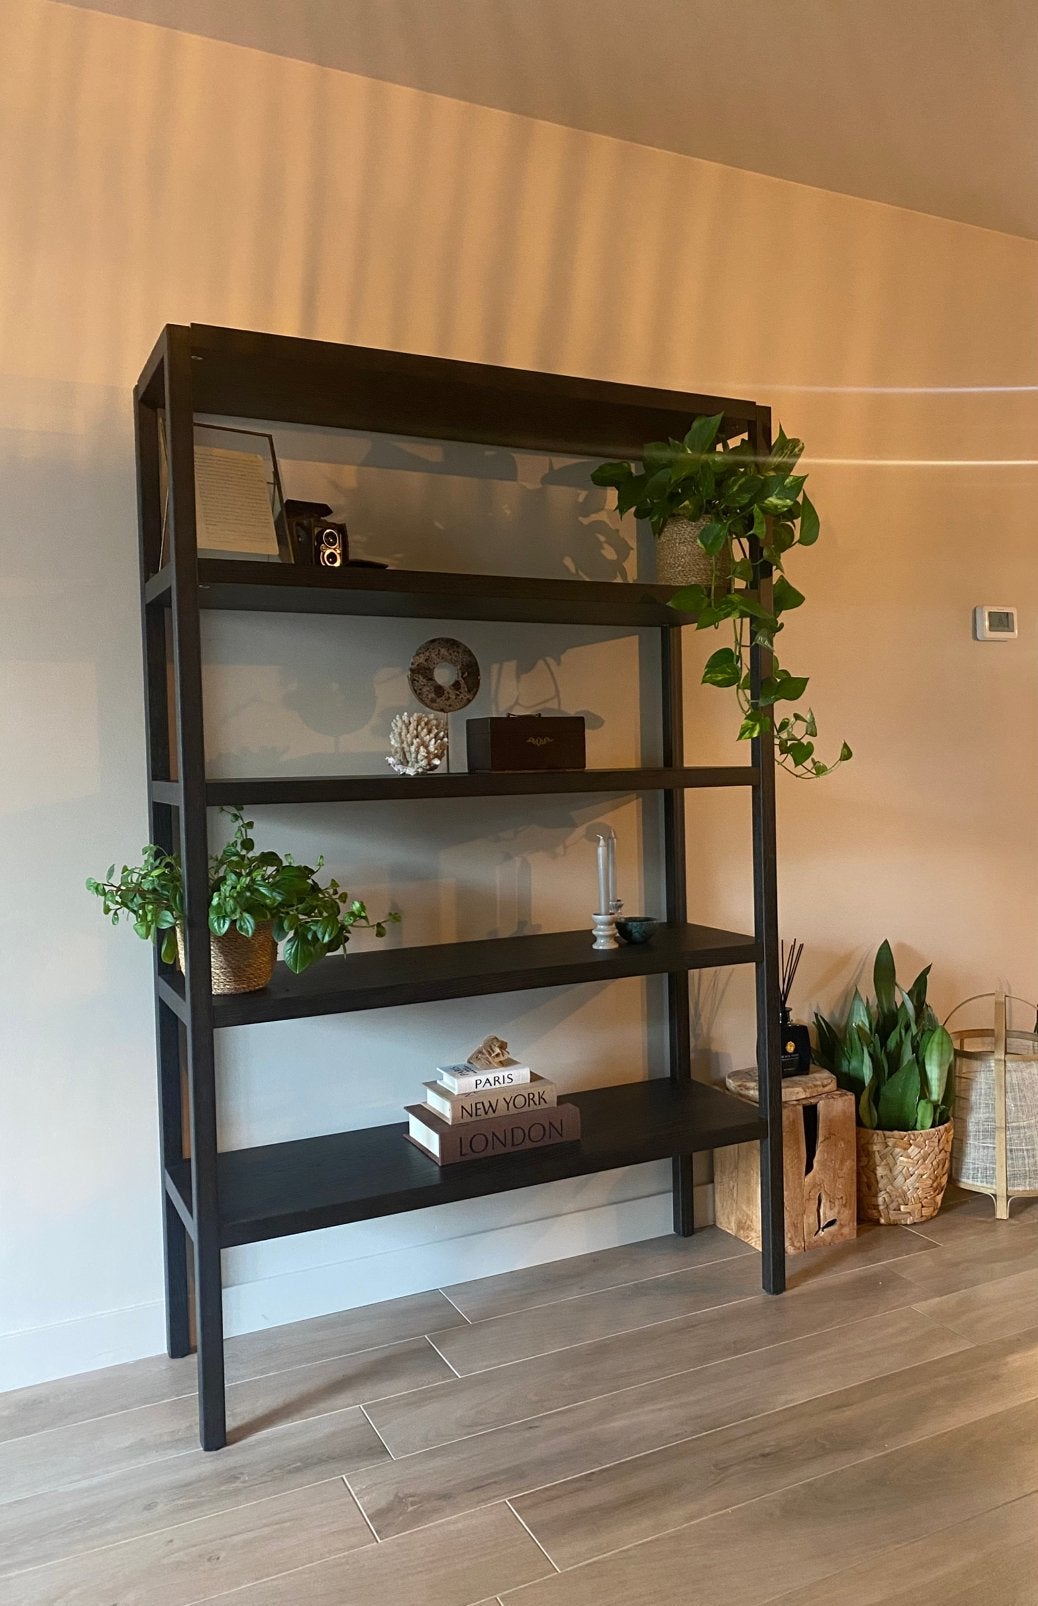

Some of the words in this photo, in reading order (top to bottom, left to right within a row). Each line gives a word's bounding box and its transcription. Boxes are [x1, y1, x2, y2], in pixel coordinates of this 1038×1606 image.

[474, 1073, 514, 1089] PARIS
[460, 1098, 499, 1120] NEW
[503, 1090, 548, 1112] YORK
[458, 1118, 564, 1157] LONDON
